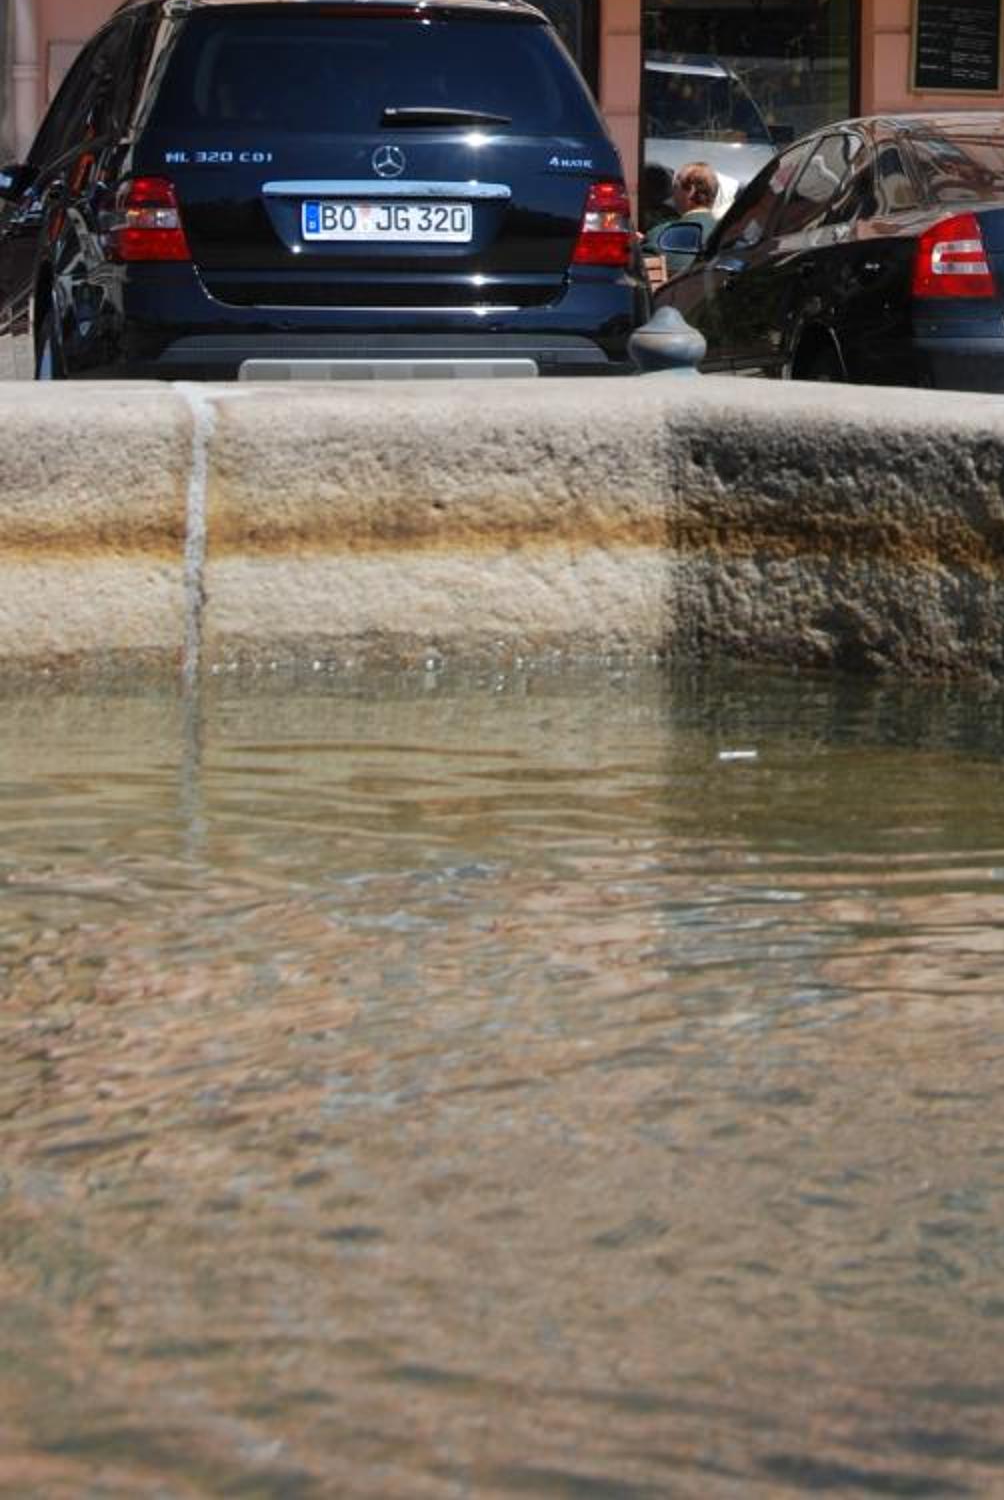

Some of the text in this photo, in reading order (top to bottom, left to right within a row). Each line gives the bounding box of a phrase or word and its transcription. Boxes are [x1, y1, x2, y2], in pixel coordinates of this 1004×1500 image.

[195, 151, 234, 163] 320
[239, 151, 273, 163] CDI
[321, 205, 466, 233] BO JG 320
